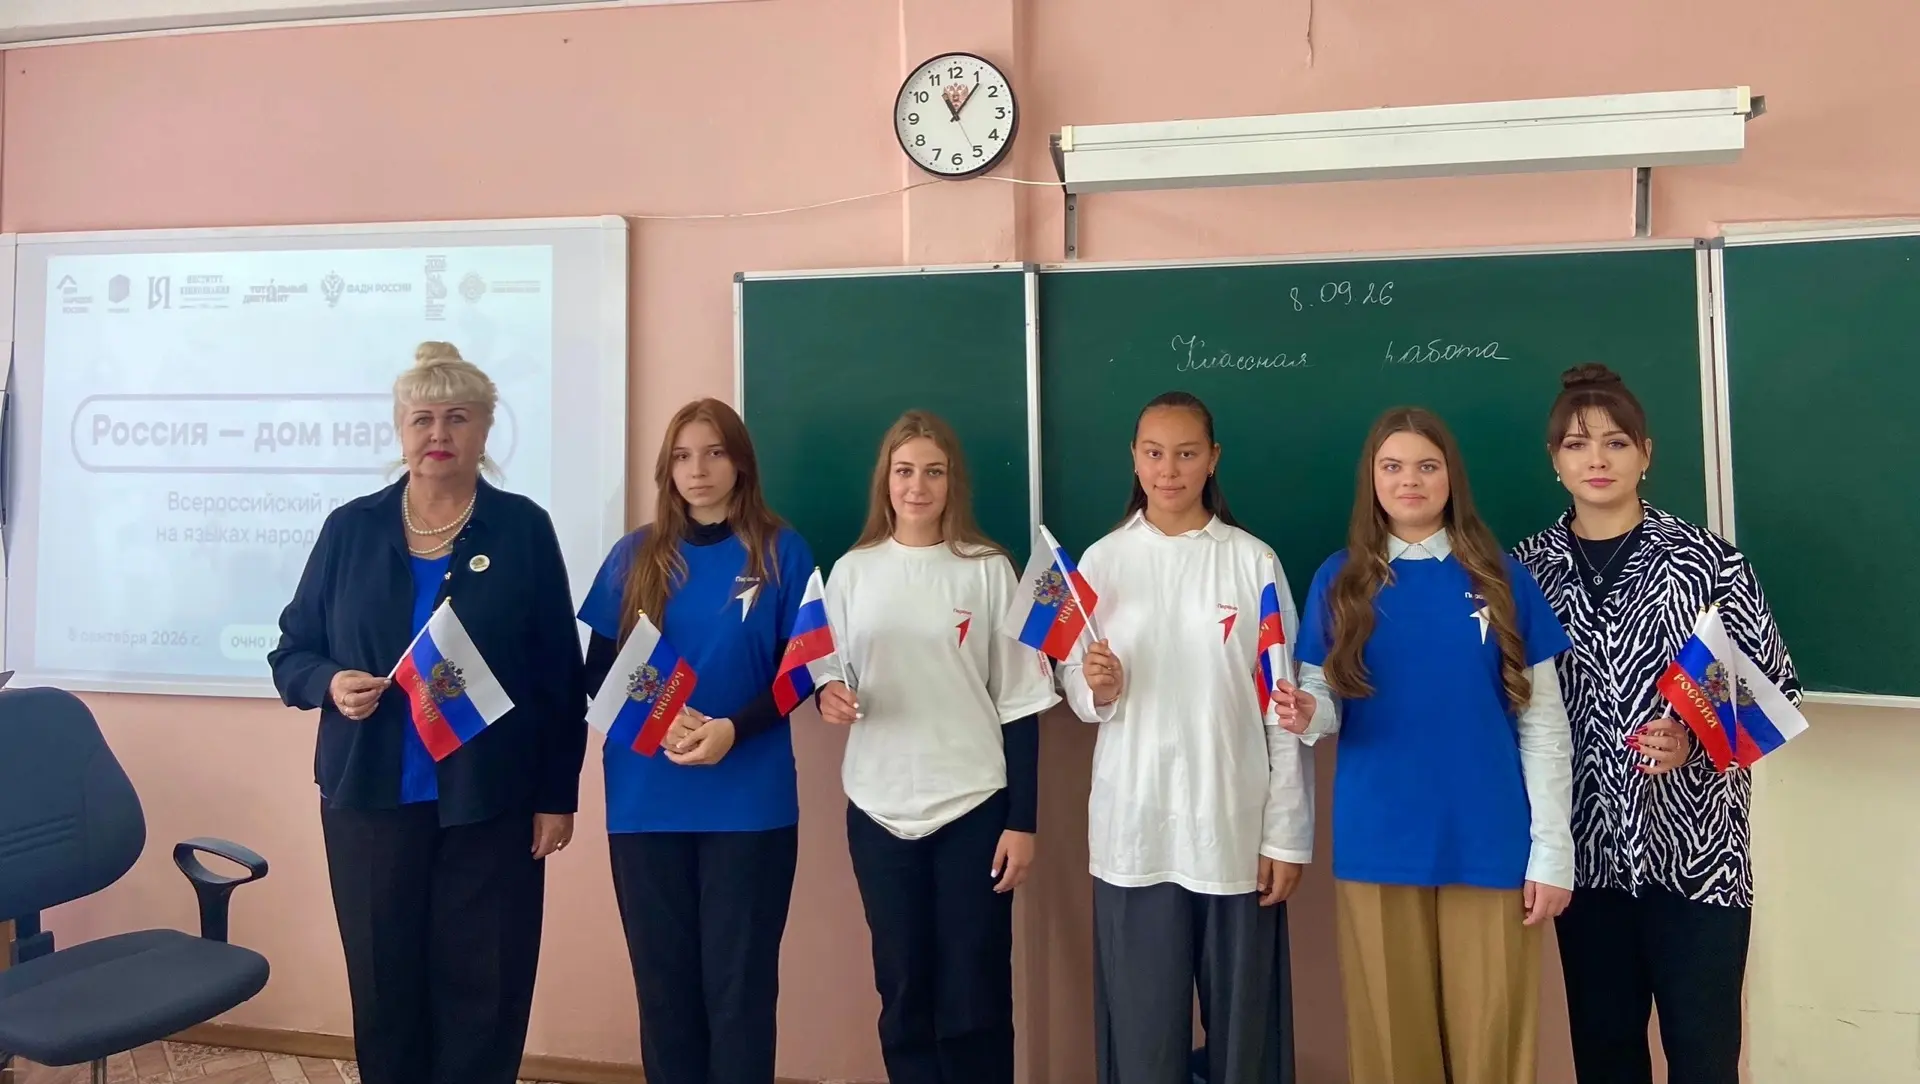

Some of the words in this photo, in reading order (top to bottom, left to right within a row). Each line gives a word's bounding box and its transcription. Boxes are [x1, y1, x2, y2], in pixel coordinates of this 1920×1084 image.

[947, 67, 963, 79] 12
[973, 71, 980, 82] 1
[929, 74, 941, 86] 11
[913, 91, 929, 103] 10
[987, 86, 998, 98] 2
[908, 113, 920, 125] 9
[995, 107, 1006, 119] 3
[915, 134, 926, 146] 8
[988, 128, 999, 140] 4
[932, 148, 942, 160] 7
[972, 145, 983, 157] 5
[951, 153, 963, 165] 6
[1172, 334, 1314, 372] Классная
[92, 414, 208, 446] Россия
[254, 421, 321, 452] дом
[332, 421, 394, 455] нар
[168, 491, 321, 516] Всероссийский
[157, 528, 177, 543] на
[184, 528, 249, 544] языках
[257, 529, 317, 548] народ
[151, 630, 188, 646] 2026
[231, 635, 266, 649] очно
[1673, 673, 1718, 728] РОССИЯ
